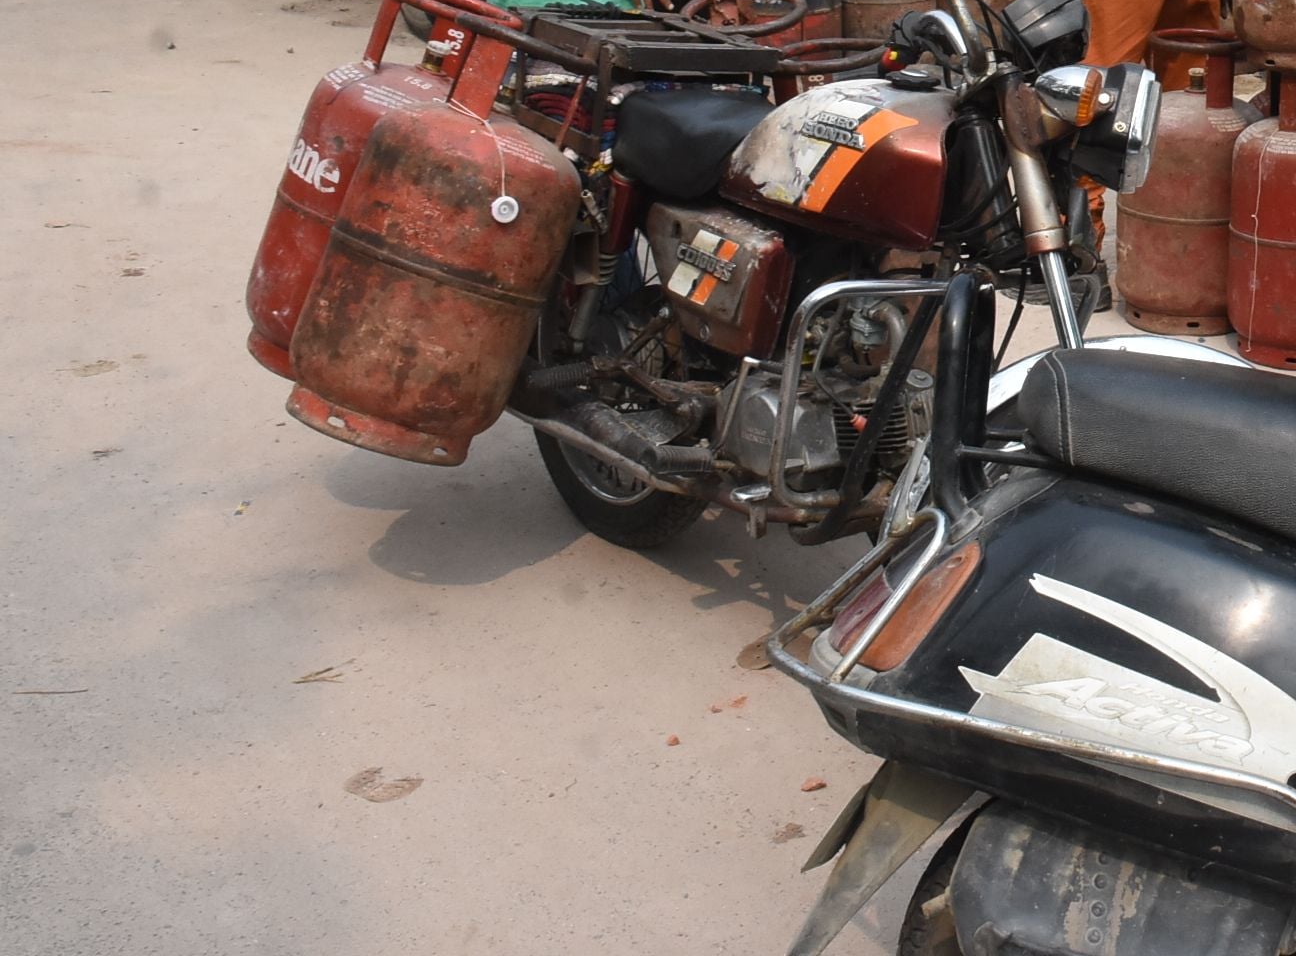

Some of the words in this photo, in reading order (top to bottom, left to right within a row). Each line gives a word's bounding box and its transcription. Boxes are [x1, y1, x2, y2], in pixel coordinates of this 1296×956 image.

[812, 110, 859, 128] HERO
[1016, 676, 1255, 764] Activa
[1120, 682, 1229, 723] Honda
